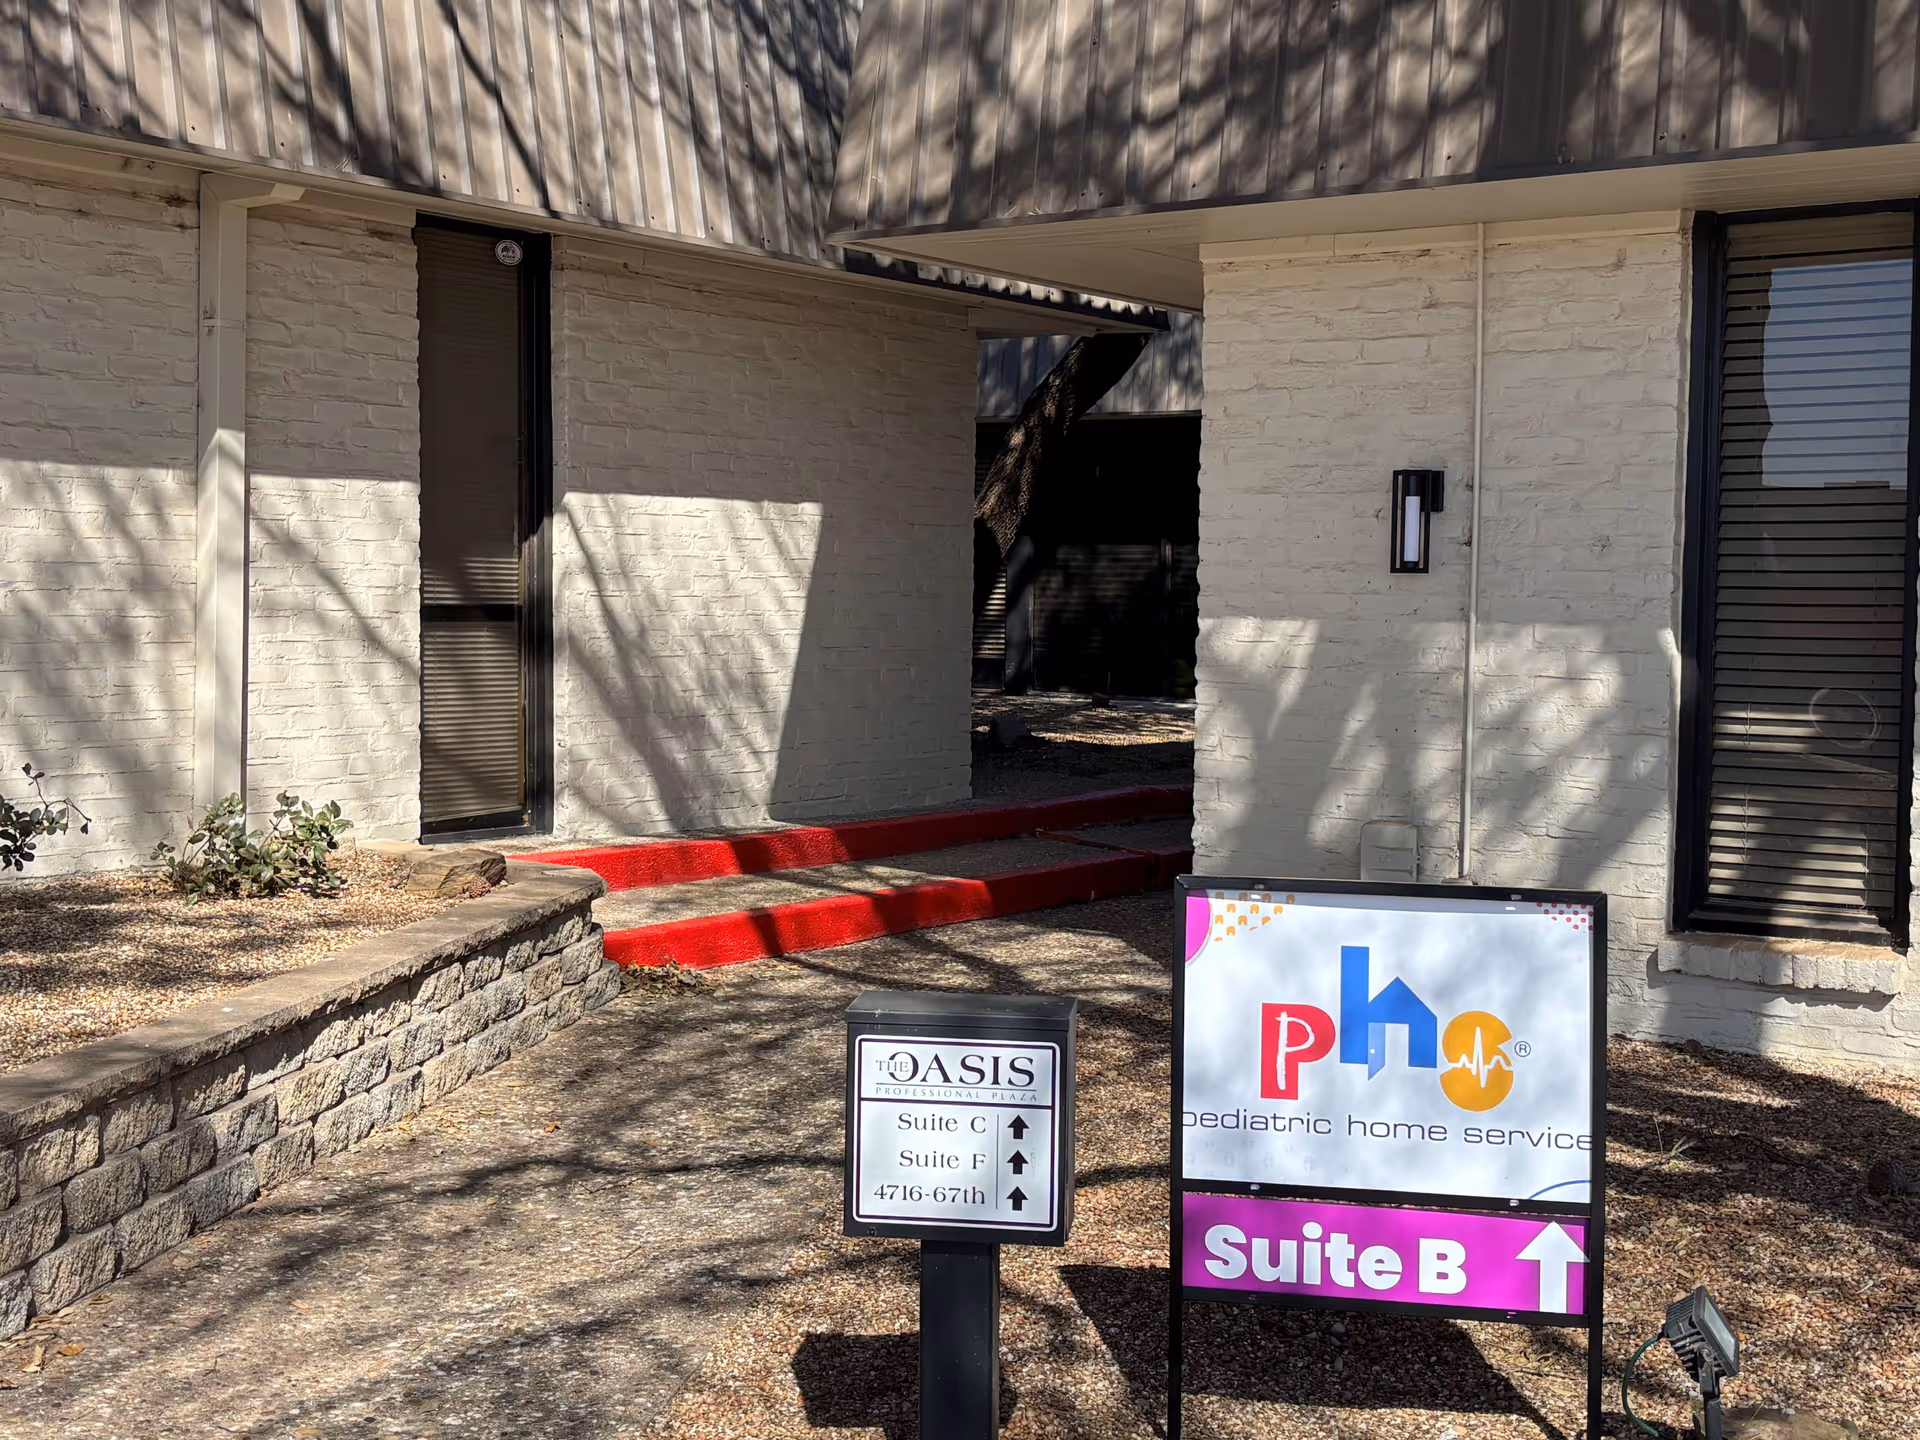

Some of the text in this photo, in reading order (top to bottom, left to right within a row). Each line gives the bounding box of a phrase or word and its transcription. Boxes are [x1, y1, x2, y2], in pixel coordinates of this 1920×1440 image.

[875, 1051, 1035, 1087] THE OASIS
[875, 1086, 1037, 1102] PROFESSIONAL PLAZA
[897, 1113, 987, 1133] Suite C
[1347, 1114, 1448, 1143] home
[899, 1150, 987, 1170] Suite F
[873, 1183, 986, 1205] 4716-67th
[1204, 1221, 1467, 1295] Suite B
